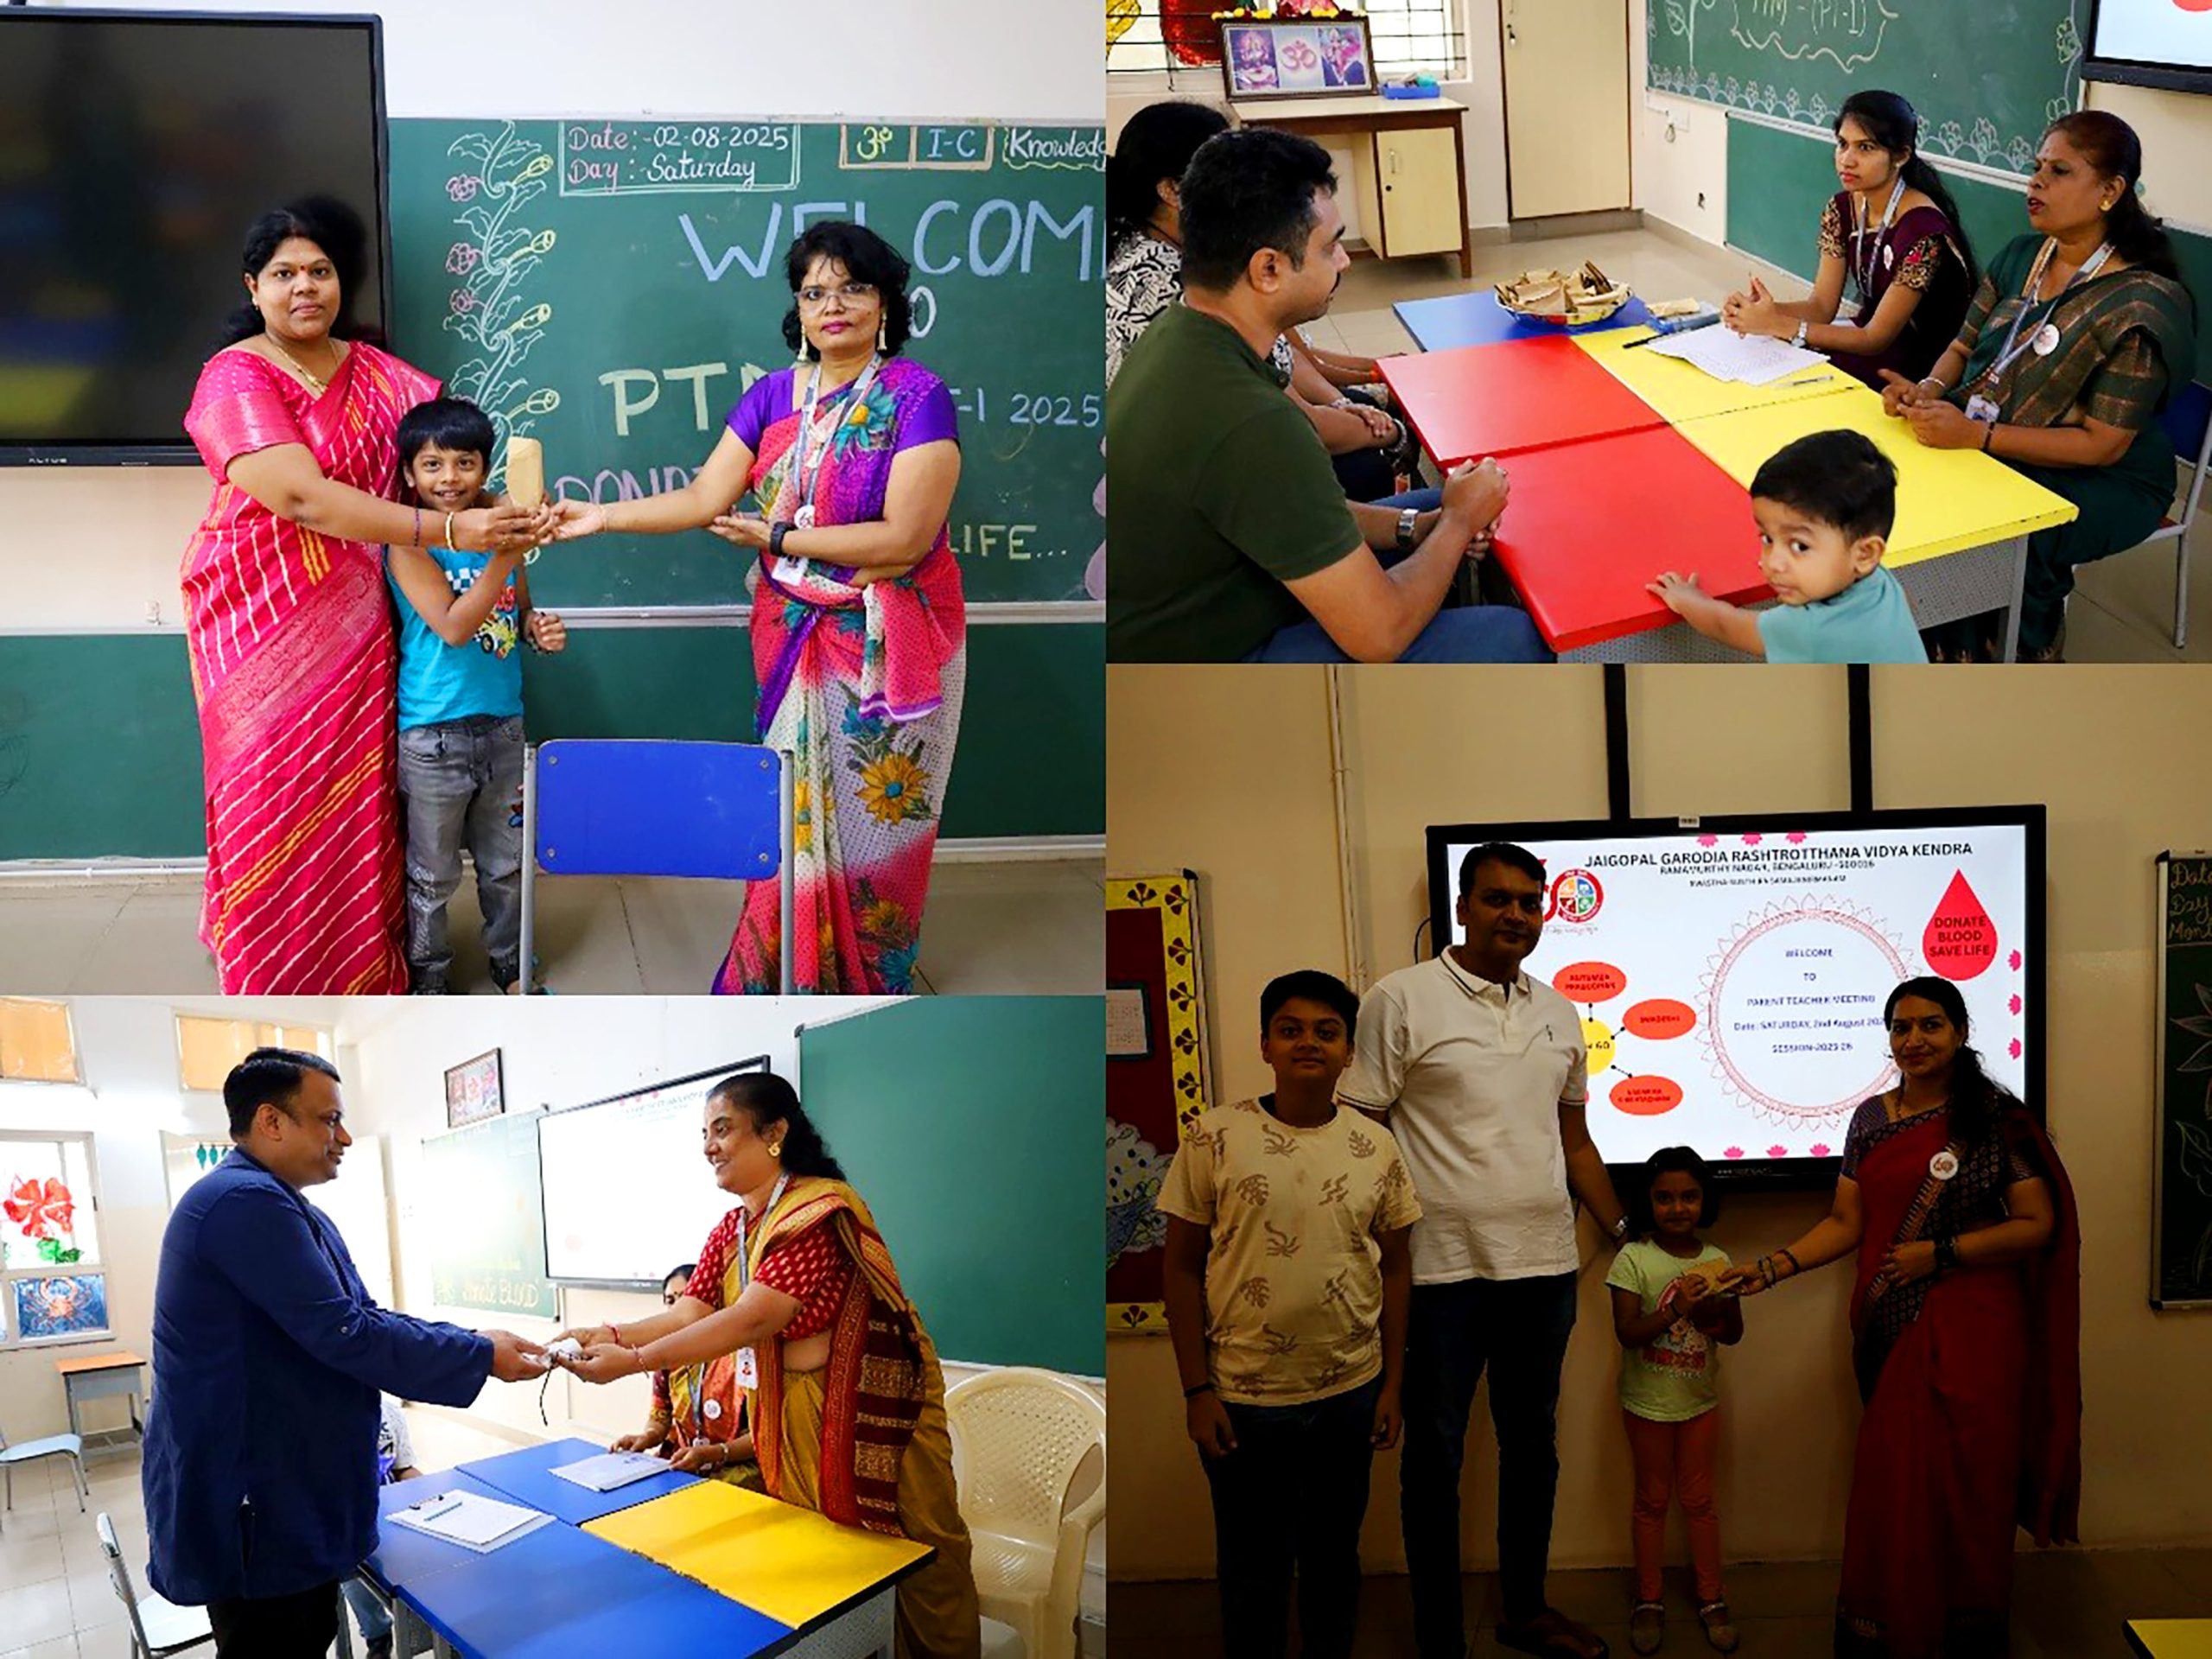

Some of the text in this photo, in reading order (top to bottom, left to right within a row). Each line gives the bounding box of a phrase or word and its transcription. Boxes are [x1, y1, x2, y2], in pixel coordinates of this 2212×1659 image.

[927, 128, 976, 158] I-C
[568, 158, 619, 194] Day
[1009, 393, 1101, 428] 2025
[1584, 842, 1974, 868] JAIGOPAL GARODIA RASHTROTTHANA VIDYA KENDRA
[1934, 915, 1986, 929] DONATE
[1937, 930, 1983, 944] BLOOD
[1785, 948, 1834, 958] WELCOME
[1929, 944, 1990, 958] SAVE LIFE
[1803, 972, 1817, 982] TO
